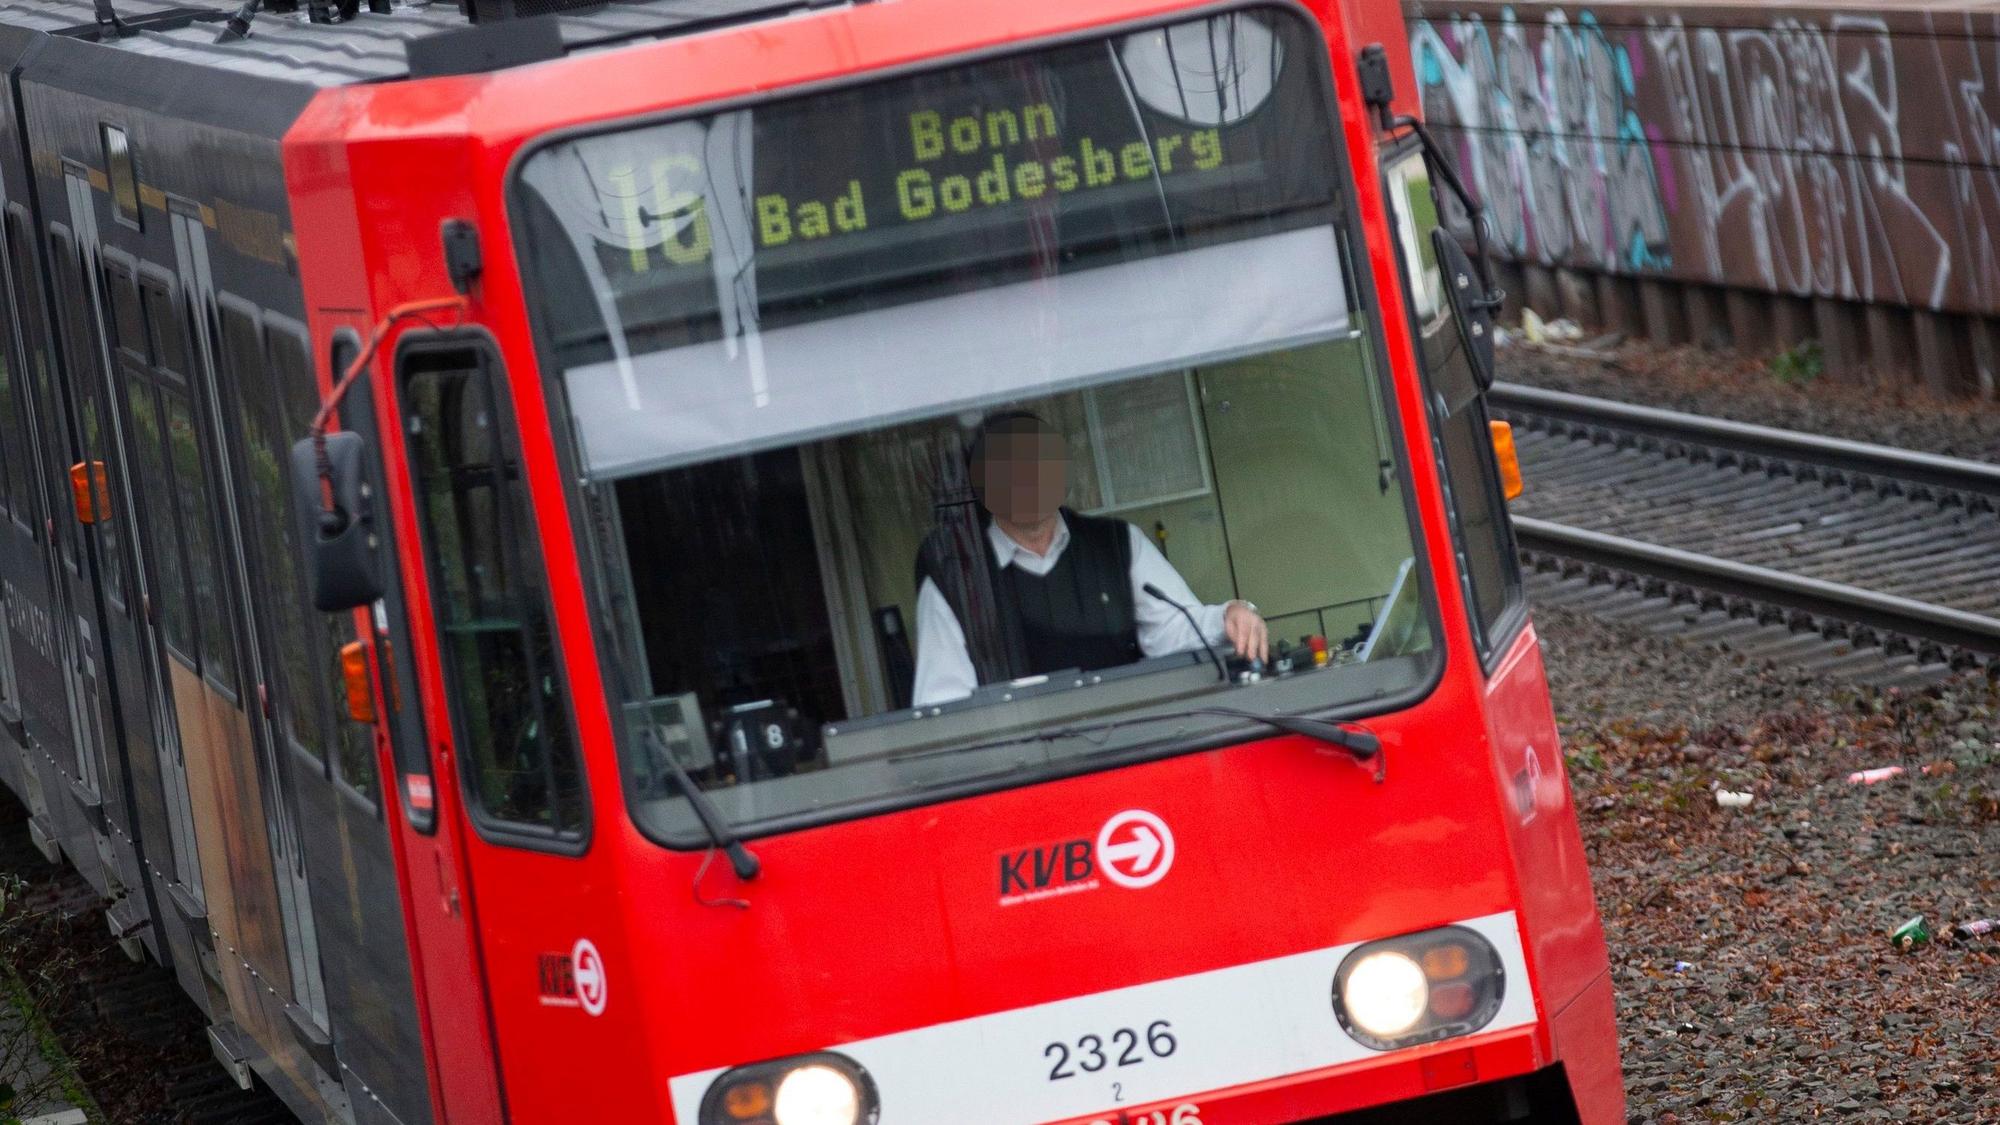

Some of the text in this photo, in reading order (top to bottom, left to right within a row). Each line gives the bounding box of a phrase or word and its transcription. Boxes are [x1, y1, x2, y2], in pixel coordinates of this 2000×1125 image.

[910, 103, 1057, 161] Bonn
[607, 155, 712, 272] 16
[756, 127, 1223, 247] Bad Godesberg
[1000, 839, 1093, 894] KVB
[1044, 1020, 1177, 1081] 2326
